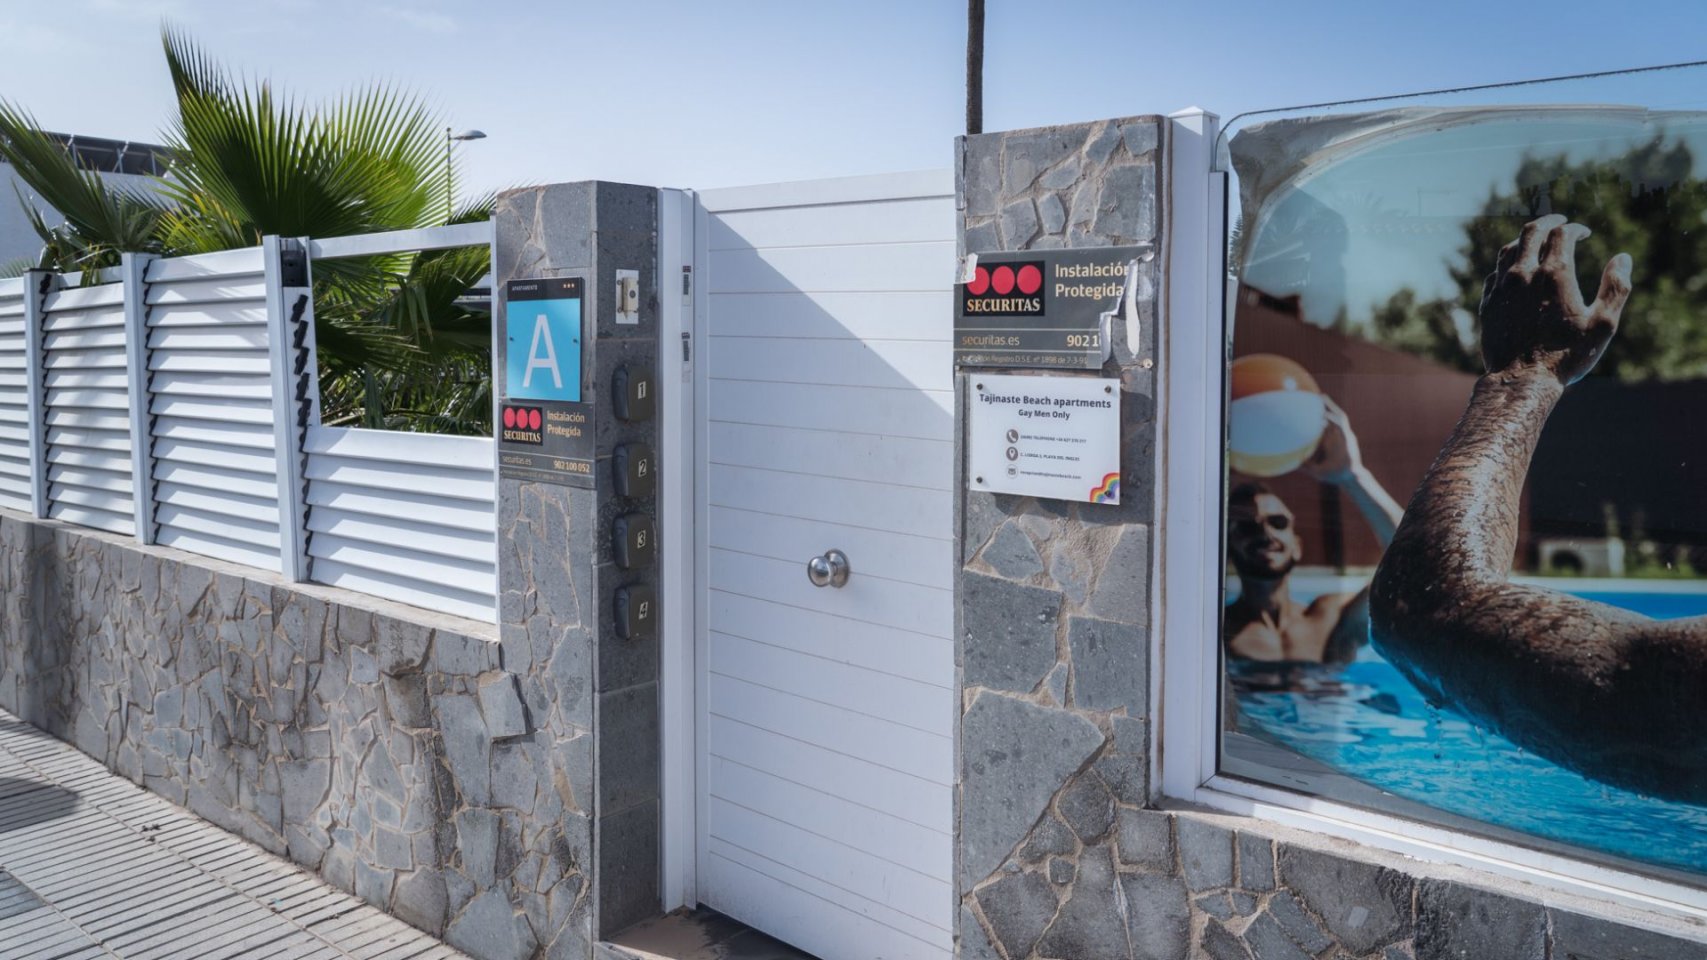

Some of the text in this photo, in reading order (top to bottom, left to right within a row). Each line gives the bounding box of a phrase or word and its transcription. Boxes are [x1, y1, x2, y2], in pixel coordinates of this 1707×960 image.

[1055, 282, 1124, 300] Protegida
[967, 298, 1040, 312] SECURITAS
[962, 335, 1020, 346] securitas.es
[1066, 335, 1089, 347] 902
[522, 314, 563, 388] A
[639, 383, 645, 398] 1
[979, 394, 1112, 408] Tajinaste Beach apartments
[547, 410, 585, 423] Instalación
[1018, 409, 1033, 418] Gay
[1052, 410, 1071, 420] Only
[504, 430, 541, 442] SECURITAS
[547, 424, 581, 438] Protegida
[554, 459, 590, 473] 902 100 052
[639, 461, 646, 476] 2
[638, 532, 645, 547] 3
[639, 603, 647, 618] 4
